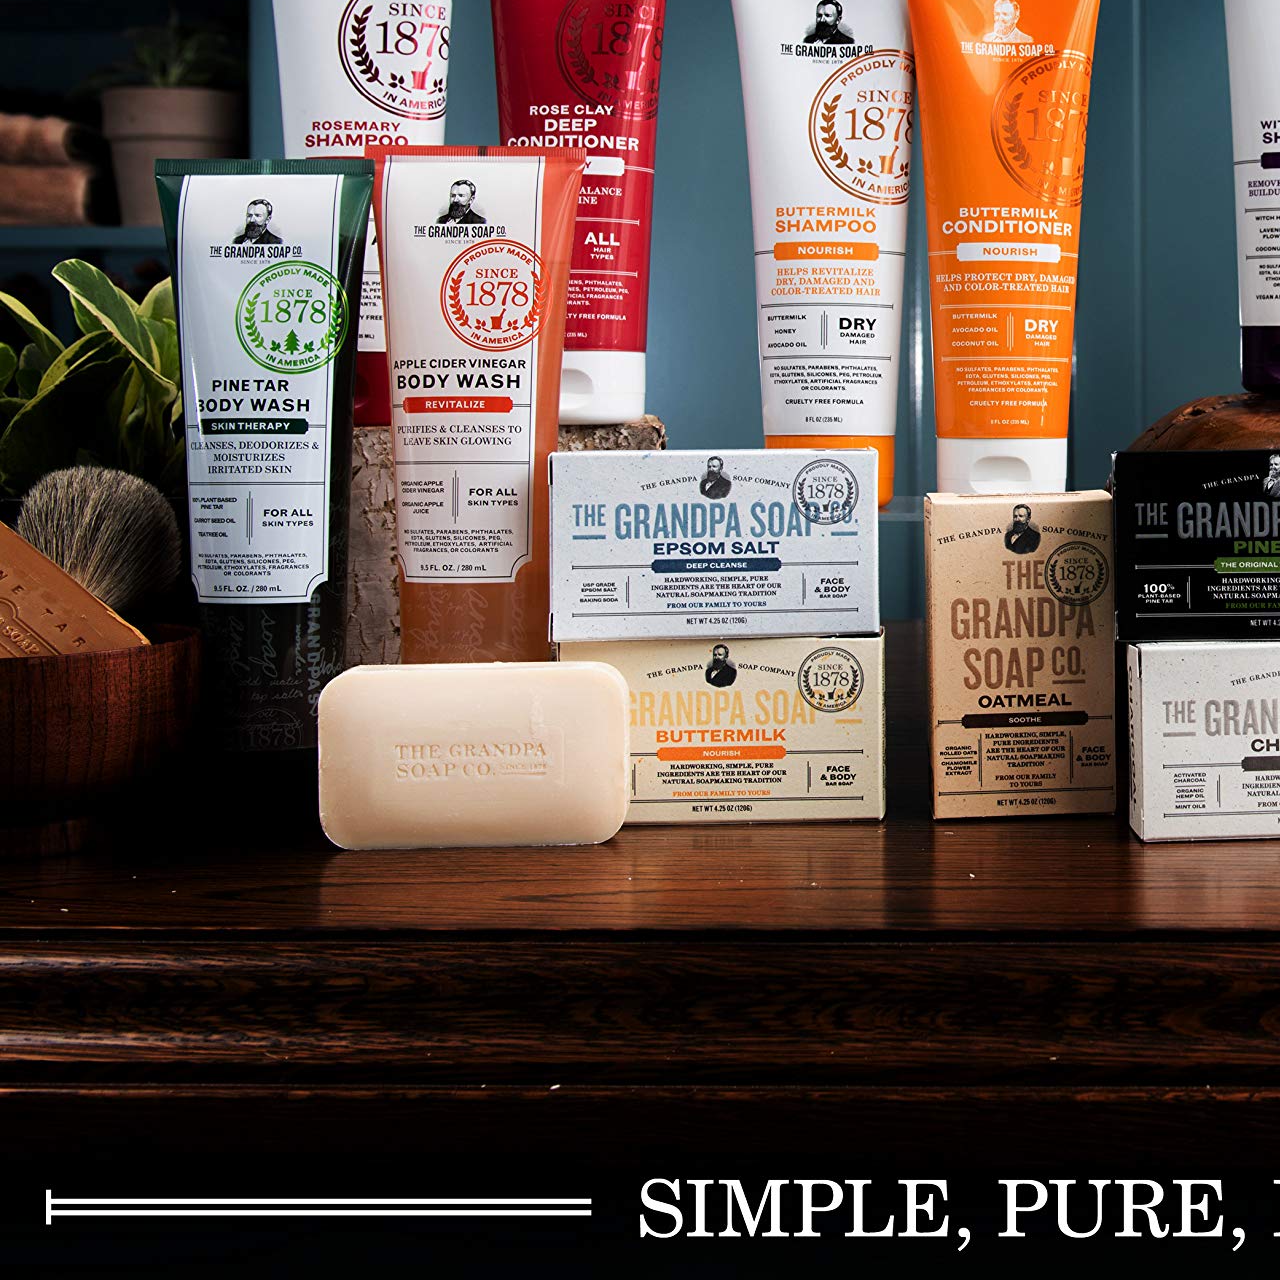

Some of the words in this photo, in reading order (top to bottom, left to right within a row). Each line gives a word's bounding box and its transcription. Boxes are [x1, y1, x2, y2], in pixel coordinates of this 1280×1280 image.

[529, 104, 570, 116] ROSE
[573, 104, 614, 116] CLAY
[311, 120, 401, 133] ROSEMARY
[545, 119, 597, 131] DEEP
[305, 134, 408, 147] SHAMPOO
[508, 135, 639, 151] CONDITIONER
[775, 206, 876, 218] BUTTERMILK
[960, 207, 1058, 219] BUTTERMILK
[775, 220, 876, 233] SHAMPOO
[942, 220, 1072, 236] CONDITIONER
[585, 232, 620, 247] ALL
[797, 245, 854, 255] NOURISH
[982, 247, 1038, 257] NOURISH
[475, 268, 519, 279] SINCE
[776, 267, 809, 277] HELPS
[811, 267, 874, 279] REVITALIZE
[273, 288, 313, 299] SINCE
[467, 281, 528, 306] 1878
[261, 300, 326, 324] 1878
[840, 318, 876, 330] DRY
[393, 360, 427, 371] APPLE
[429, 358, 467, 369] CIDER
[468, 358, 527, 369] VINEGAR
[213, 380, 250, 392] PINE
[252, 379, 289, 392] TAR
[398, 374, 449, 389] BODY
[457, 374, 519, 388] WASH
[250, 399, 309, 412] WASH
[425, 400, 486, 409] REVITALIZE
[211, 422, 236, 431] SKIN
[237, 421, 291, 431] THERAPY
[207, 465, 263, 475] IRRITATED
[264, 465, 292, 474] SKIN
[812, 475, 838, 483] SINCE
[808, 484, 844, 499] 1878
[263, 508, 288, 518] FOR
[290, 508, 313, 517] ALL
[1135, 503, 1168, 525] THE
[261, 520, 284, 528] SKIN
[654, 542, 725, 556] EPSOM
[731, 541, 779, 554] SALT
[685, 562, 709, 570] DEEP
[709, 561, 748, 569] CLEANSE
[1220, 561, 1237, 569] THE
[1002, 560, 1044, 590] THE
[1143, 583, 1175, 594] 100%
[952, 597, 1094, 640] GRANDPA
[40, 608, 86, 647] TAR
[964, 647, 1045, 690] SOAP
[1052, 646, 1086, 676] CO.
[978, 693, 1072, 708] OATMEAL
[1008, 716, 1042, 724] SOOTHE
[656, 729, 786, 743] BUTTERMILK
[395, 744, 441, 759] THE
[449, 743, 546, 757] GRANDPA
[702, 749, 741, 757] NOURISH
[397, 763, 456, 778] SOAP
[463, 763, 495, 777] CO.
